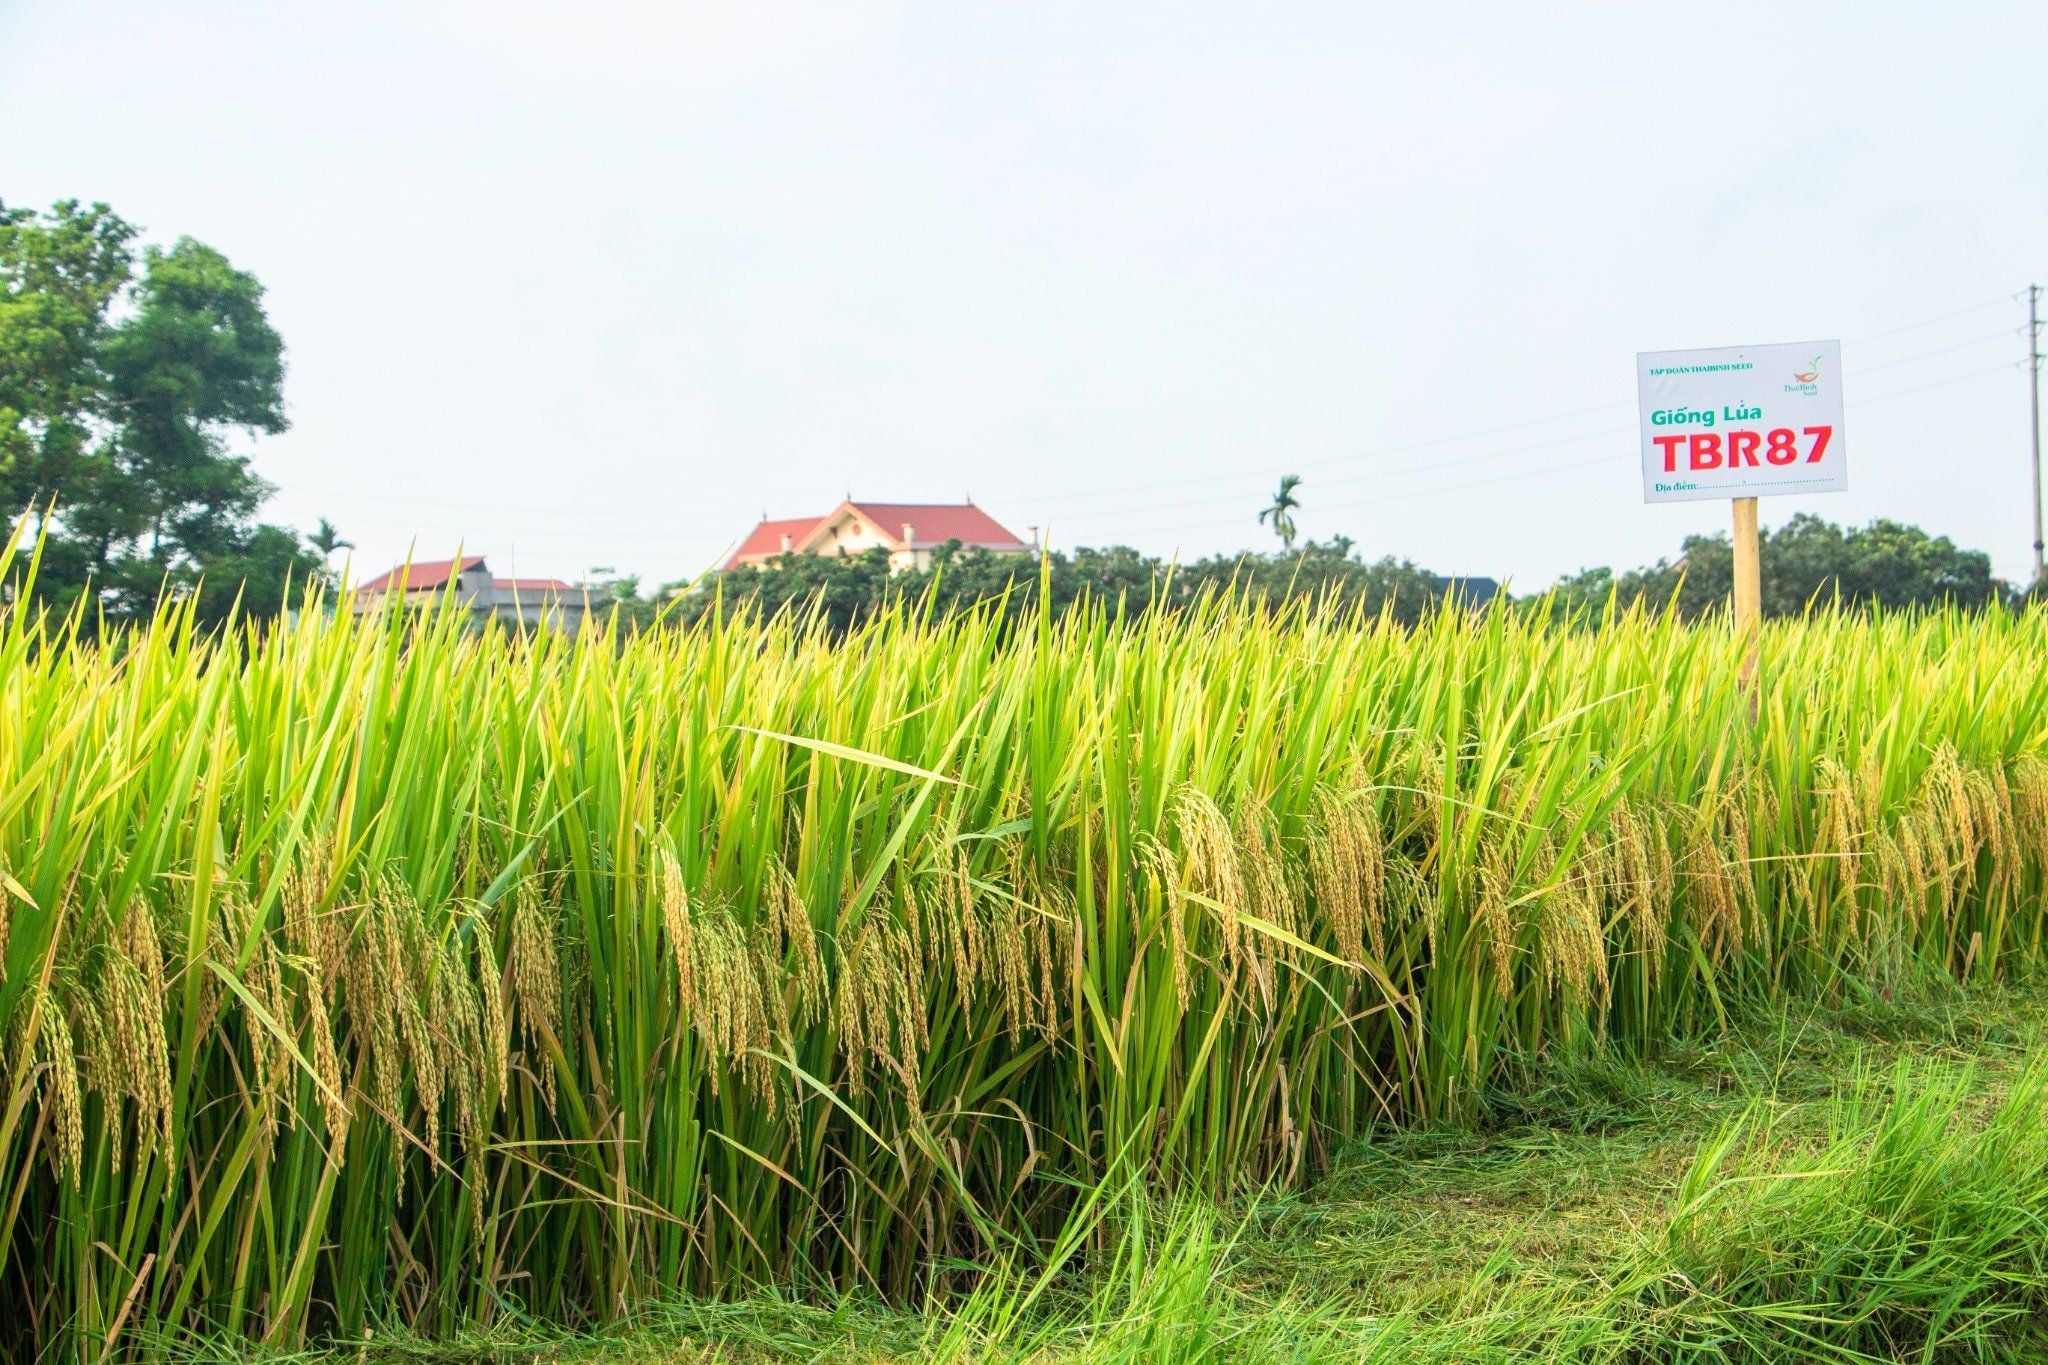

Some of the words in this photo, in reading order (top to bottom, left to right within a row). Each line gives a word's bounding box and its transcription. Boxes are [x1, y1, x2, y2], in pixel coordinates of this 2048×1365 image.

[1731, 362, 1753, 370] SEED
[1651, 406, 1715, 427] Giống
[1724, 404, 1762, 421] Lúa
[1653, 425, 1832, 472] TBR87
